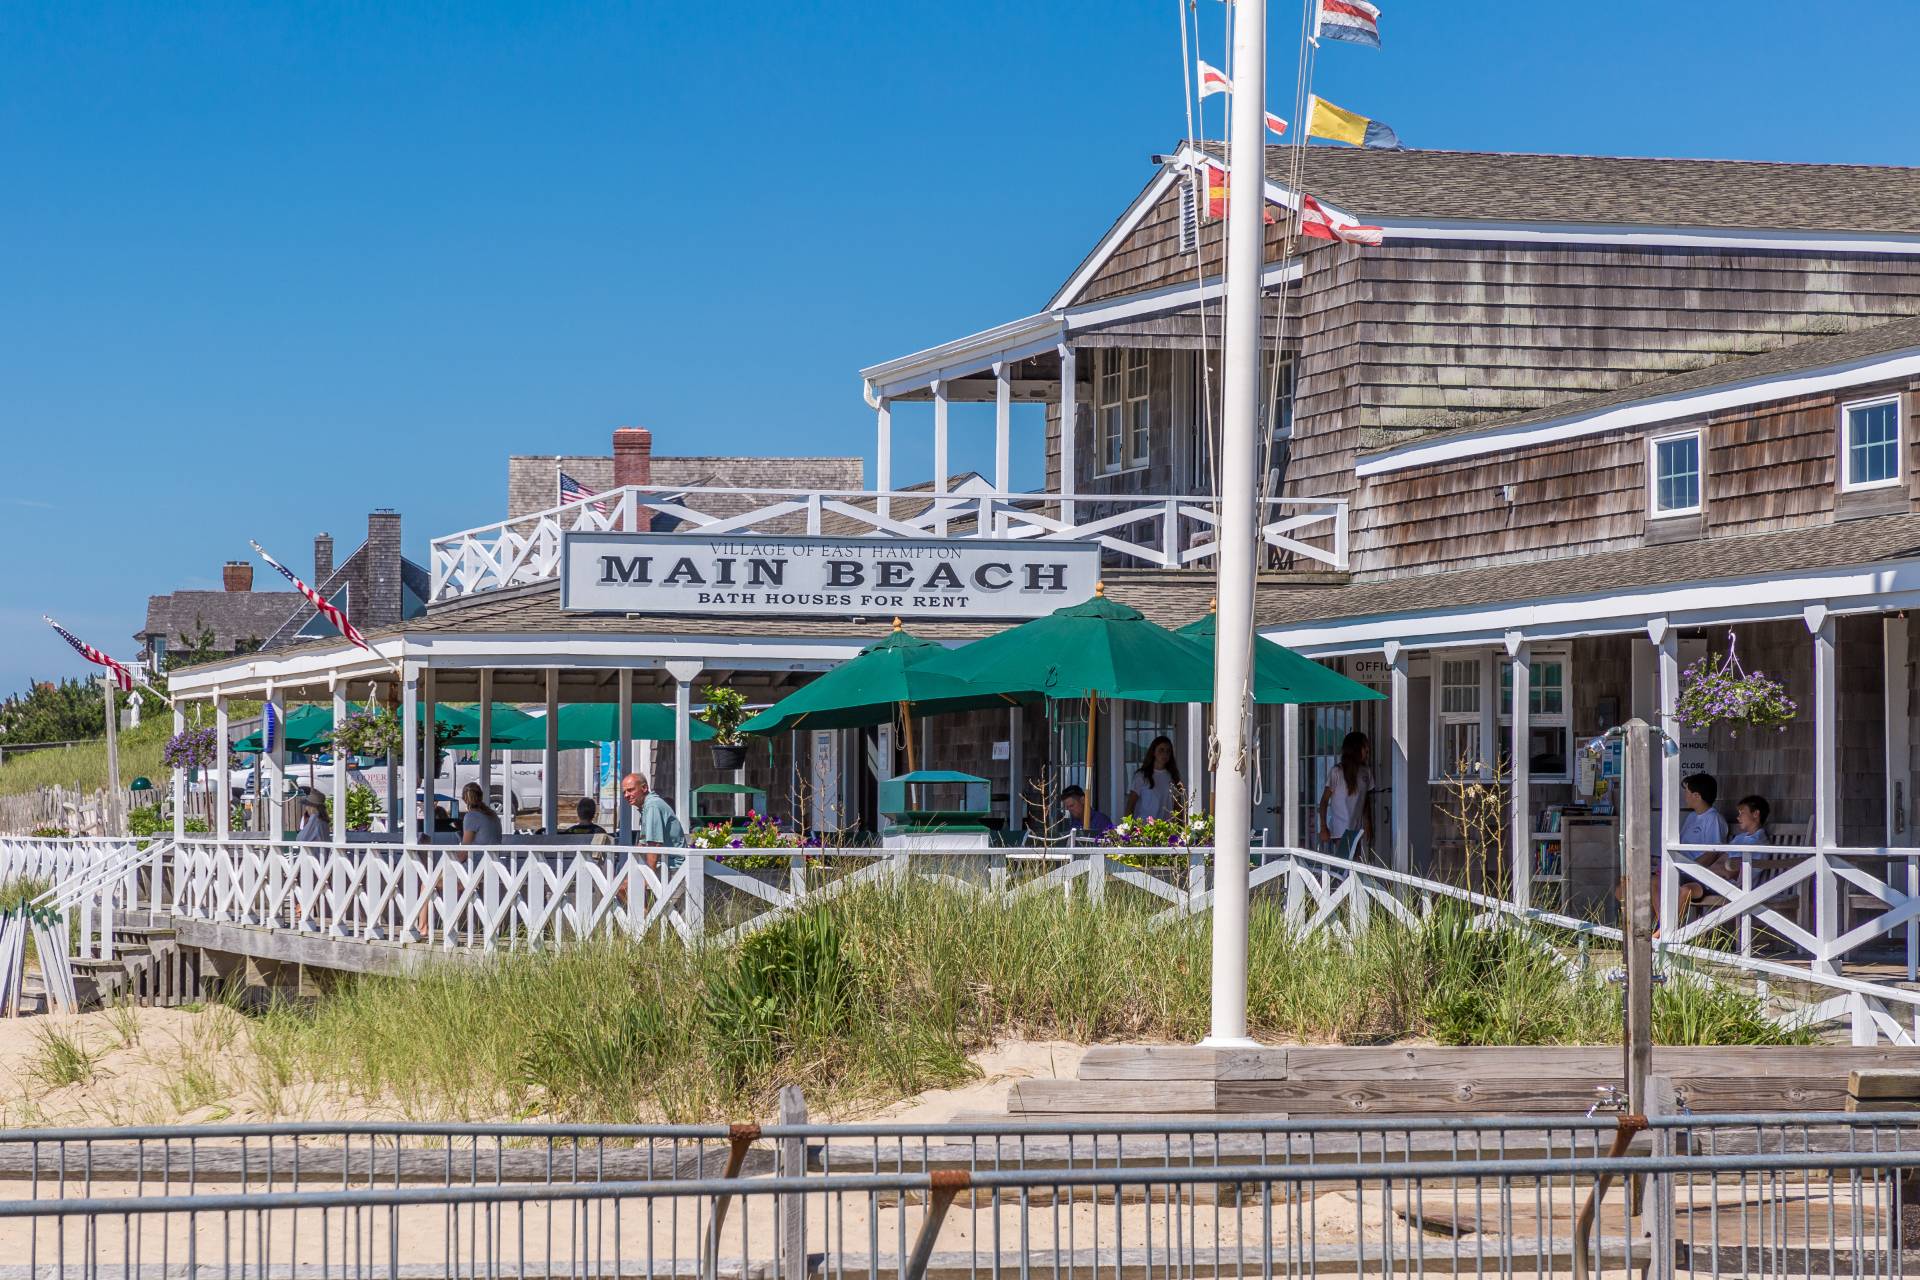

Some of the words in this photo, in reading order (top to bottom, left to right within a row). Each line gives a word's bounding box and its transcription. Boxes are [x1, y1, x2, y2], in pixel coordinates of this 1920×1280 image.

[710, 542, 785, 556] VILLAGE
[792, 544, 815, 557] OF
[821, 544, 863, 558] EAST
[872, 545, 962, 559] HAMPTON
[598, 555, 789, 588] MAIN
[824, 560, 1069, 592] BEACH
[698, 592, 755, 604] BATH
[765, 593, 851, 606] HOUSES
[860, 595, 904, 607] FOR
[912, 596, 969, 608] RENT
[1355, 661, 1392, 672] OFFIC
